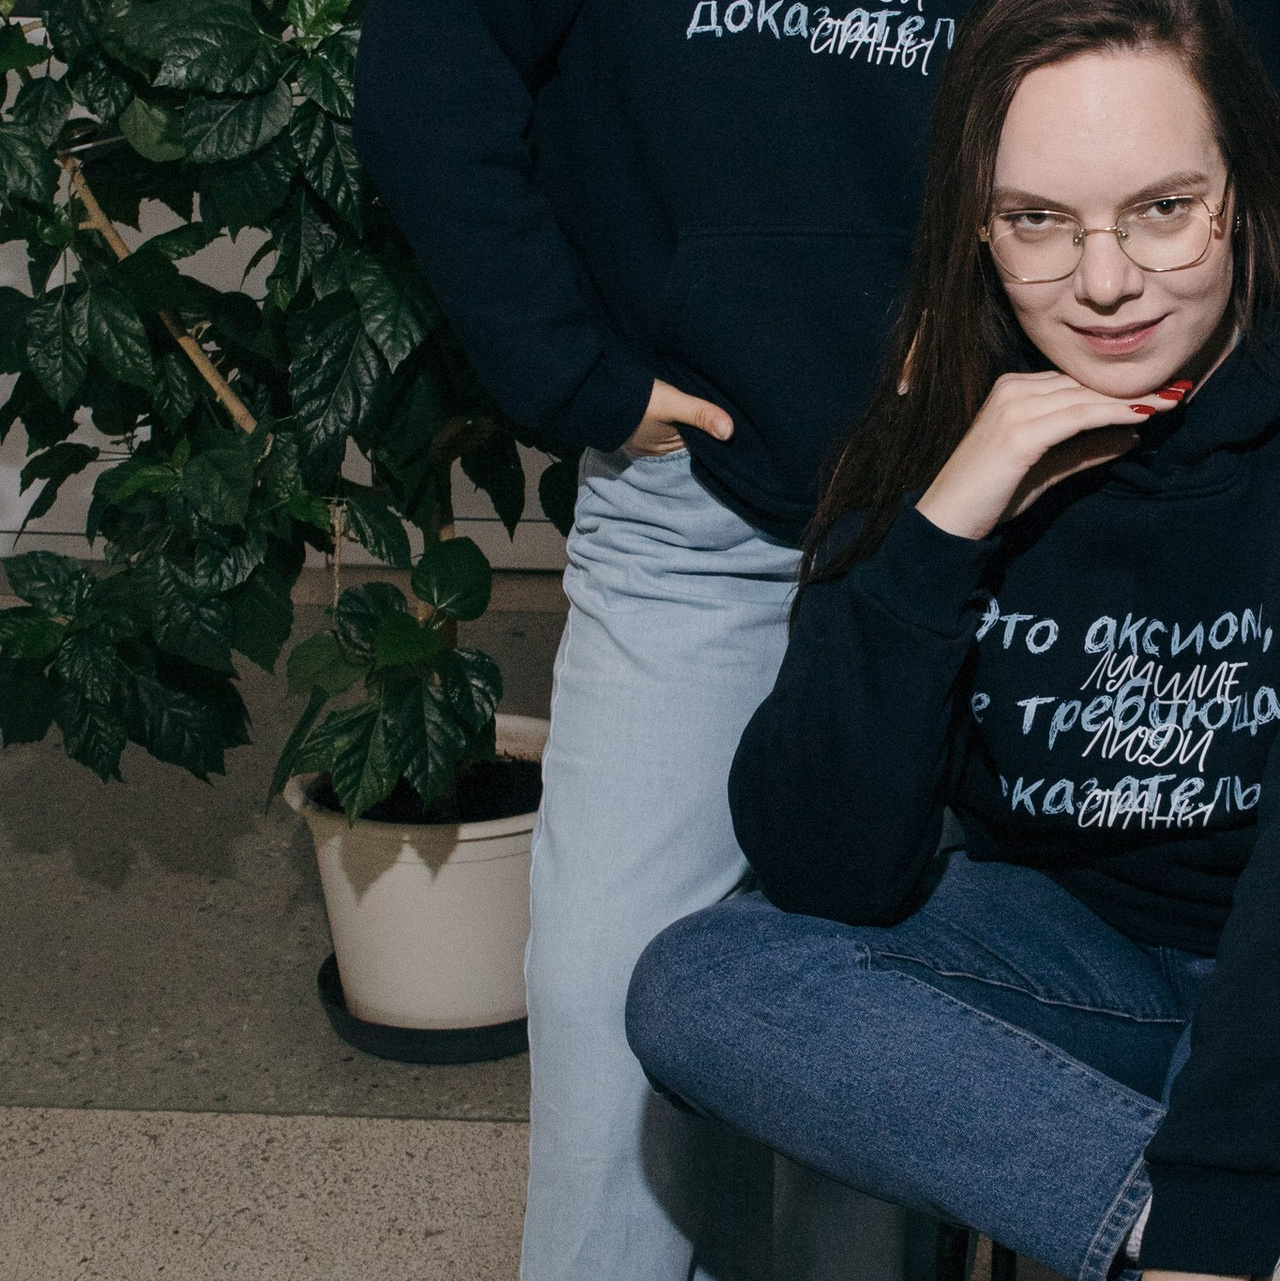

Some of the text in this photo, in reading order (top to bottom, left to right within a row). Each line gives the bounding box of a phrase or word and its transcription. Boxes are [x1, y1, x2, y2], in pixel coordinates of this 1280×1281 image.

[810, 19, 936, 76] СТРАНЫ
[1080, 649, 1248, 704] ЛУЧШИЕ
[1081, 716, 1215, 773] ЛЮДИ
